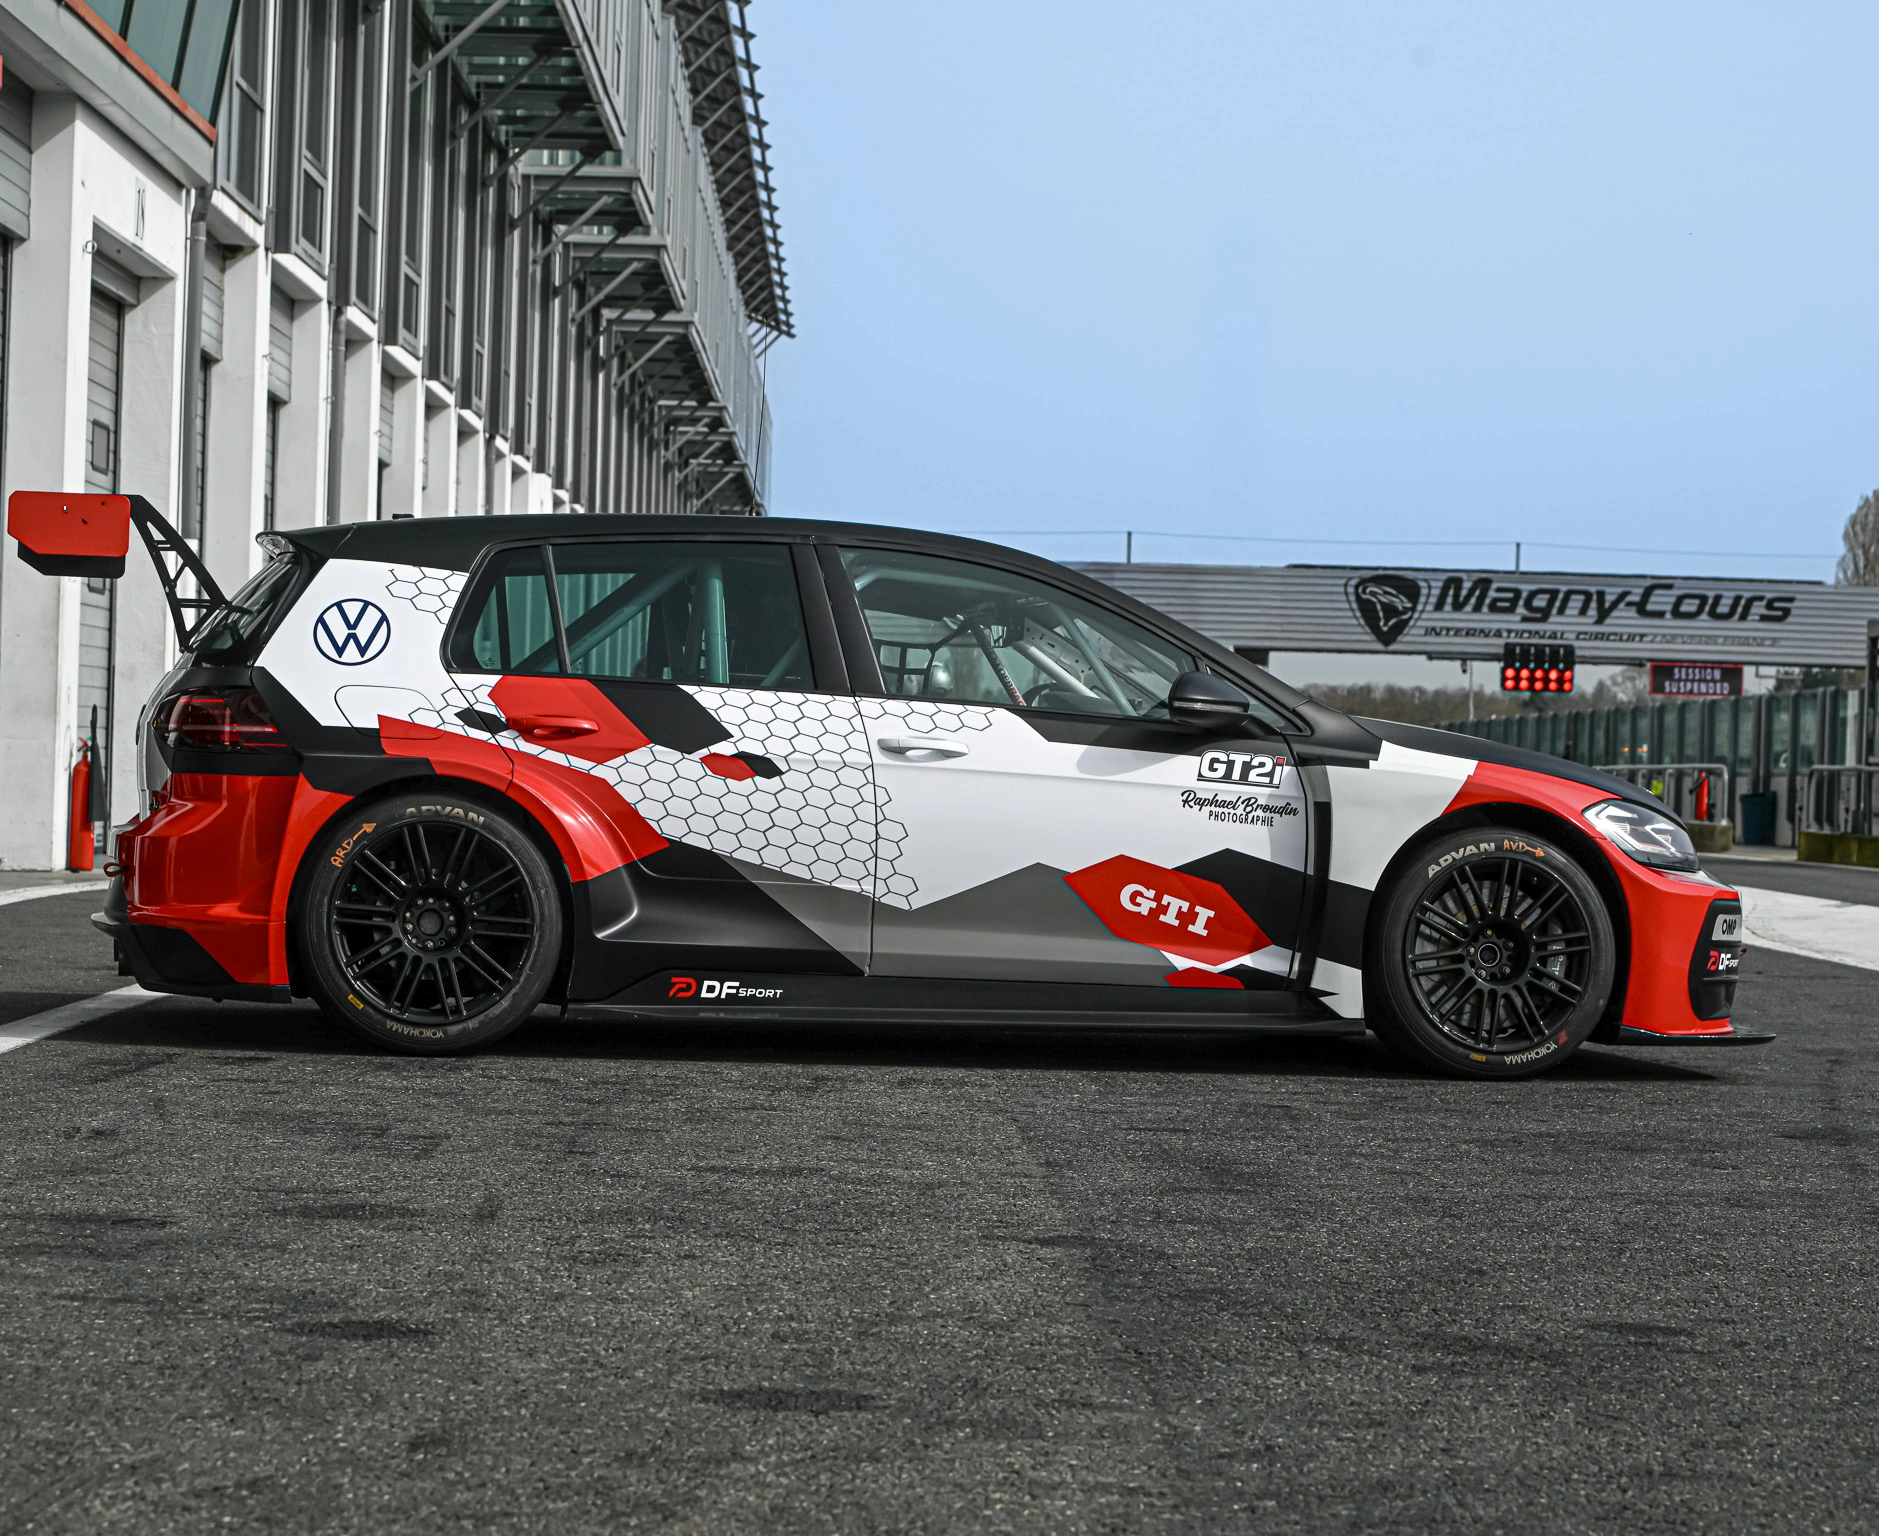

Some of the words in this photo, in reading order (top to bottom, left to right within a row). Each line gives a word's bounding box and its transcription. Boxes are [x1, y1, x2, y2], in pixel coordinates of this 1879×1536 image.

[1433, 576, 1797, 625] Magny-Cours
[1424, 626, 1570, 641] INTERNATIONAL
[1575, 631, 1648, 643] CIRCUIT
[1673, 667, 1722, 680] SESSION
[1664, 680, 1730, 695] SUSPENDED
[1199, 750, 1287, 786] GT2i
[1181, 790, 1242, 811] Raphael
[1241, 796, 1300, 817] Broudin
[404, 805, 485, 825] ADVAN
[1208, 811, 1274, 827] PHOTOGRAPHIE
[1427, 842, 1496, 879] ADVAN
[1119, 883, 1216, 937] GTI
[1721, 918, 1737, 936] OMP
[386, 1019, 445, 1039] YOKOHAMA
[1503, 1040, 1558, 1065] YOKOHAMA
